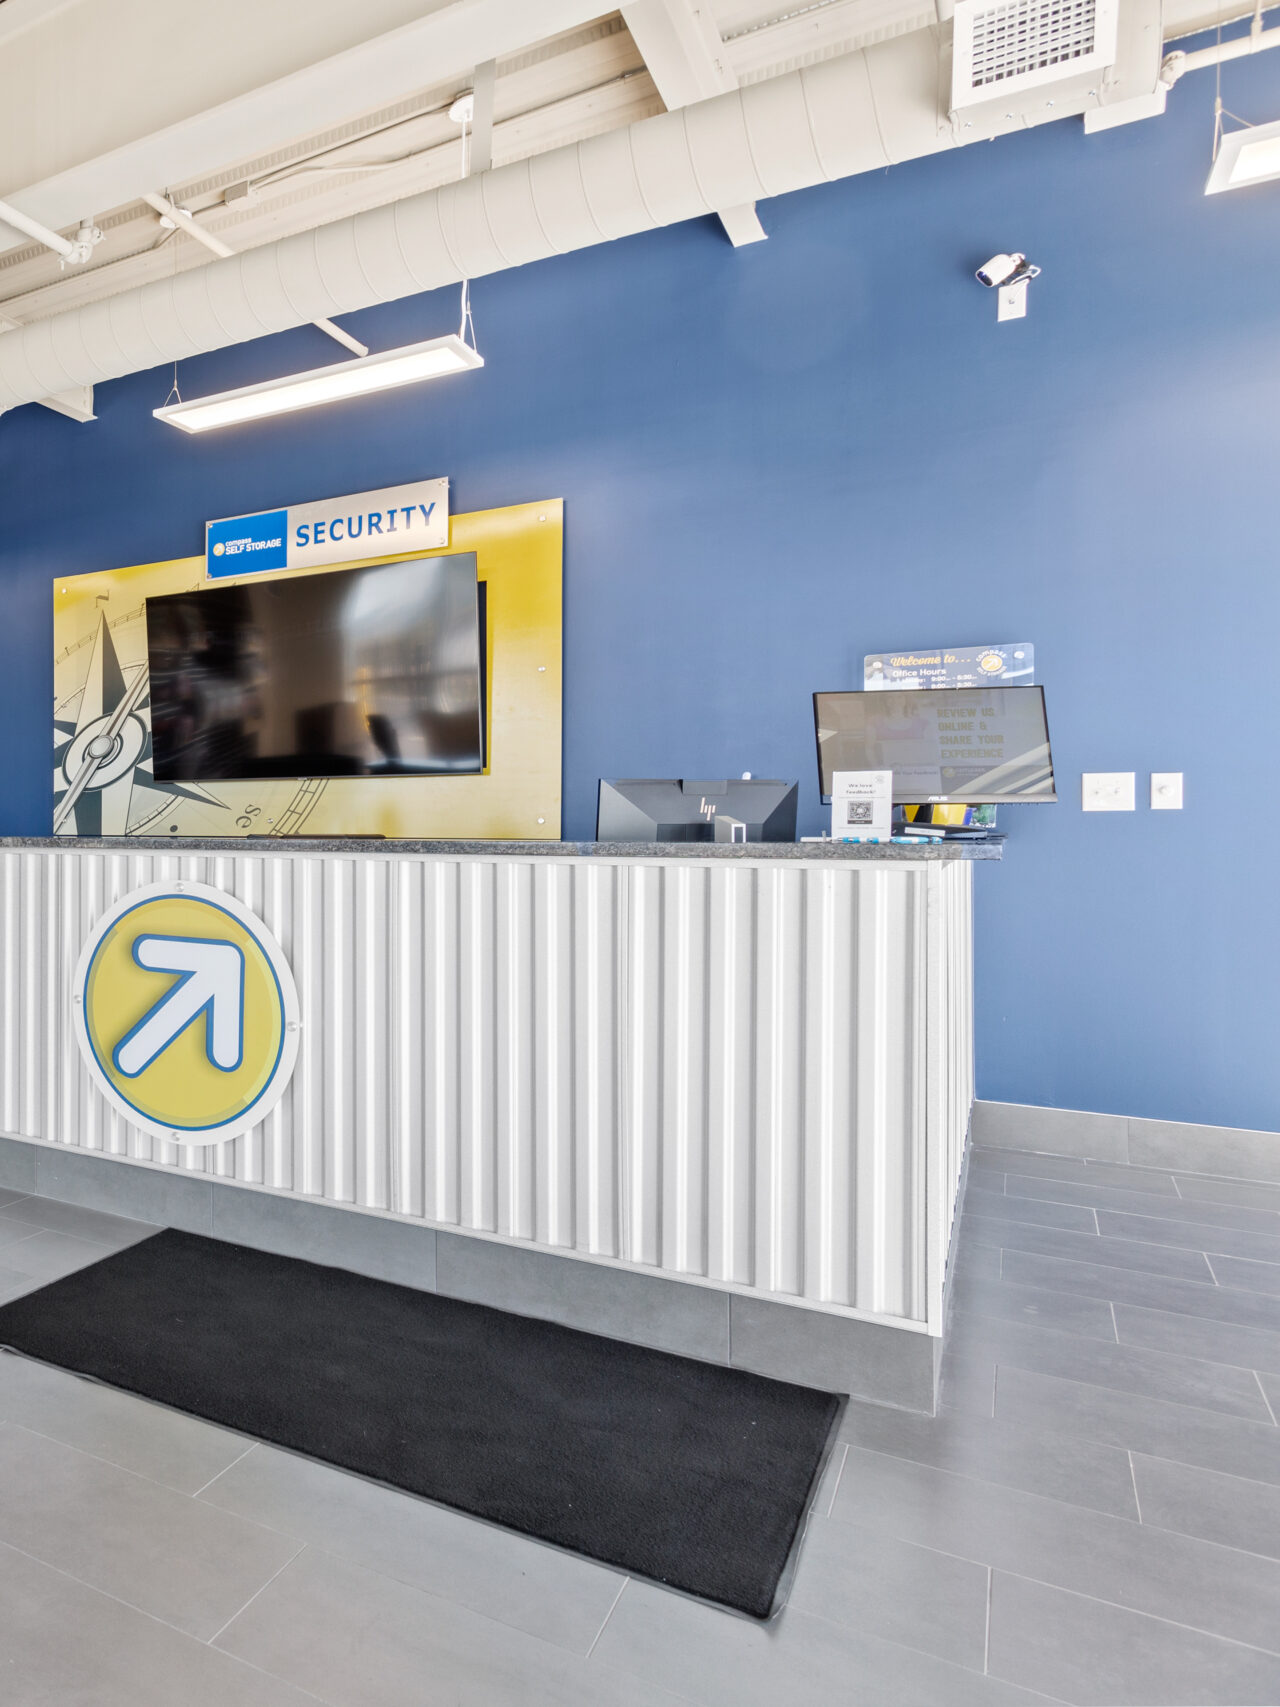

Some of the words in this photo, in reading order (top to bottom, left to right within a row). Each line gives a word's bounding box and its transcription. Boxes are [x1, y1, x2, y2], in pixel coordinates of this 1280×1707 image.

[296, 502, 436, 547] SECURITY
[225, 537, 251, 547] compass
[225, 544, 245, 555] SELF
[246, 538, 282, 552] STORAGE
[890, 655, 941, 667] Welcome
[892, 669, 918, 677] Office
[920, 668, 946, 676] Hours
[937, 708, 977, 718] REVIEW
[981, 707, 995, 717] US
[938, 722, 975, 731] ONLINE
[979, 721, 987, 730] &
[939, 735, 972, 745] SHARE
[977, 734, 1004, 744] YOUR
[941, 748, 1004, 759] EXPERIENCE
[700, 797, 716, 821] hp
